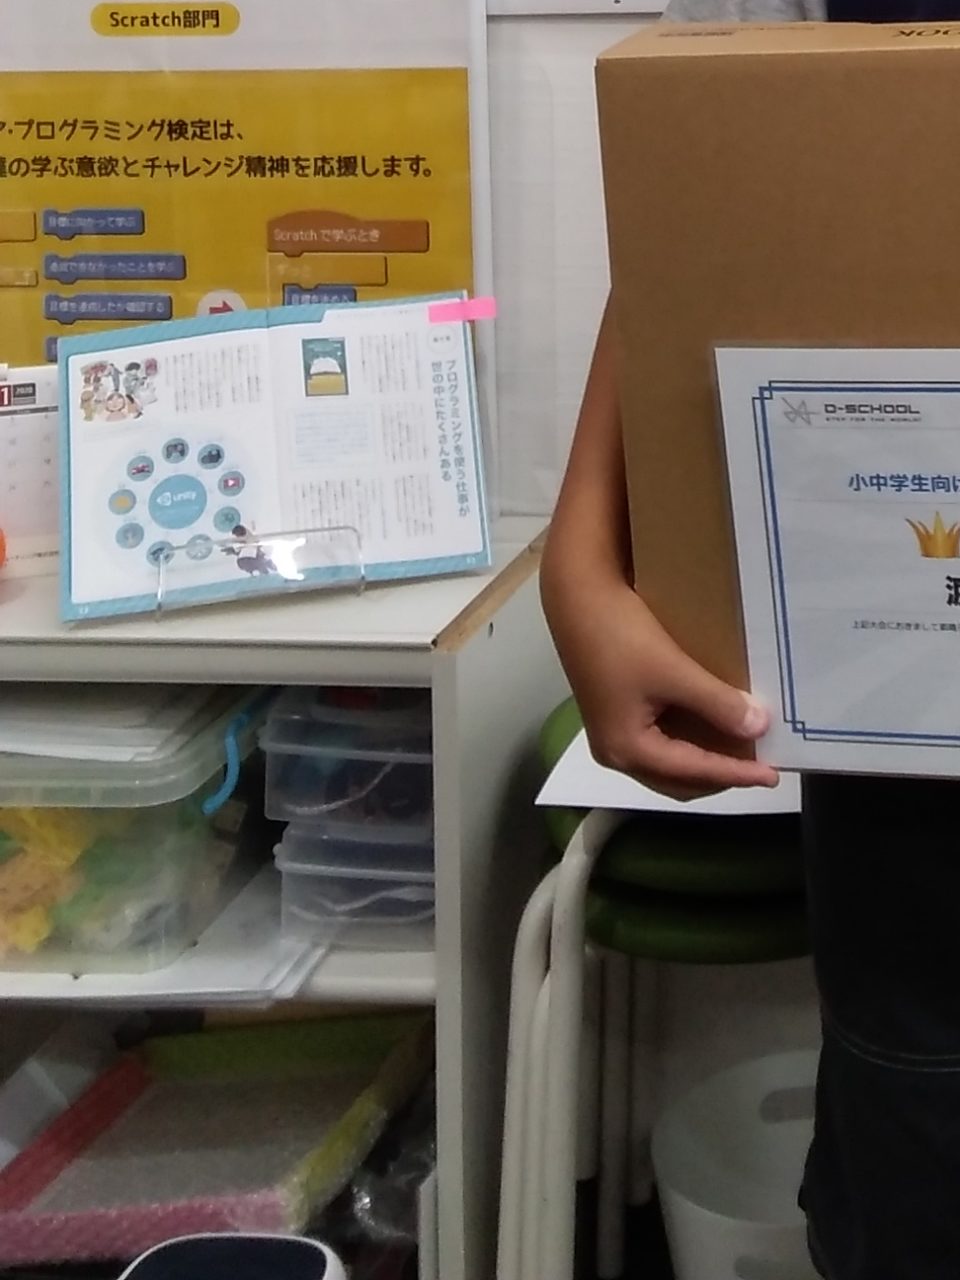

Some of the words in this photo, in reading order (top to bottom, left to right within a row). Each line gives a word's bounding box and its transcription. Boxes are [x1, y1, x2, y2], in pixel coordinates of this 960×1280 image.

[109, 9, 220, 30] Scratch部門
[273, 228, 318, 241] Scratch
[824, 403, 921, 415] D-SCHOOL
